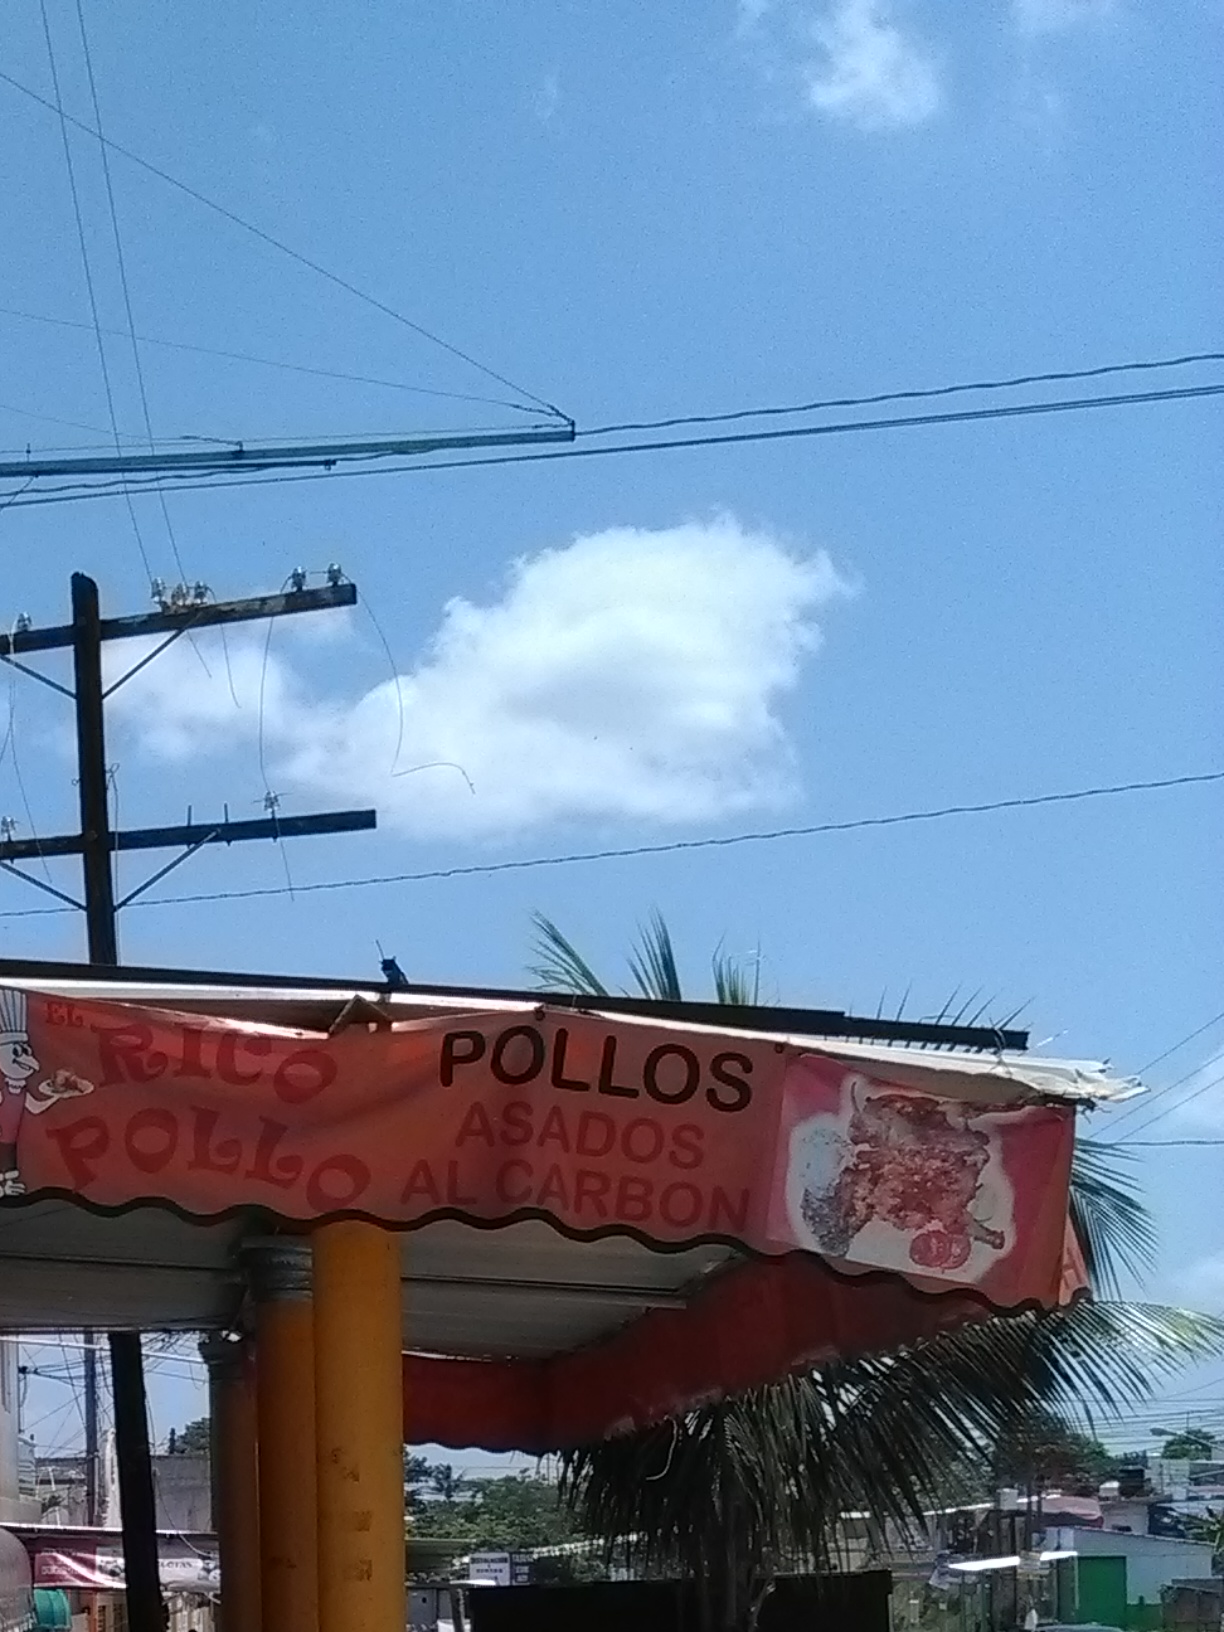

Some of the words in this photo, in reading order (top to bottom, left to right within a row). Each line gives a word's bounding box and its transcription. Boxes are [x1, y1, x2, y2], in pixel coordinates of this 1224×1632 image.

[44, 999, 85, 1028] EL
[90, 1021, 338, 1105] RICO
[439, 1025, 754, 1112] POLLOS
[45, 1105, 372, 1213] POLLO
[455, 1101, 706, 1170] ASADOS
[400, 1160, 478, 1206] AL
[494, 1160, 751, 1233] CARBON
